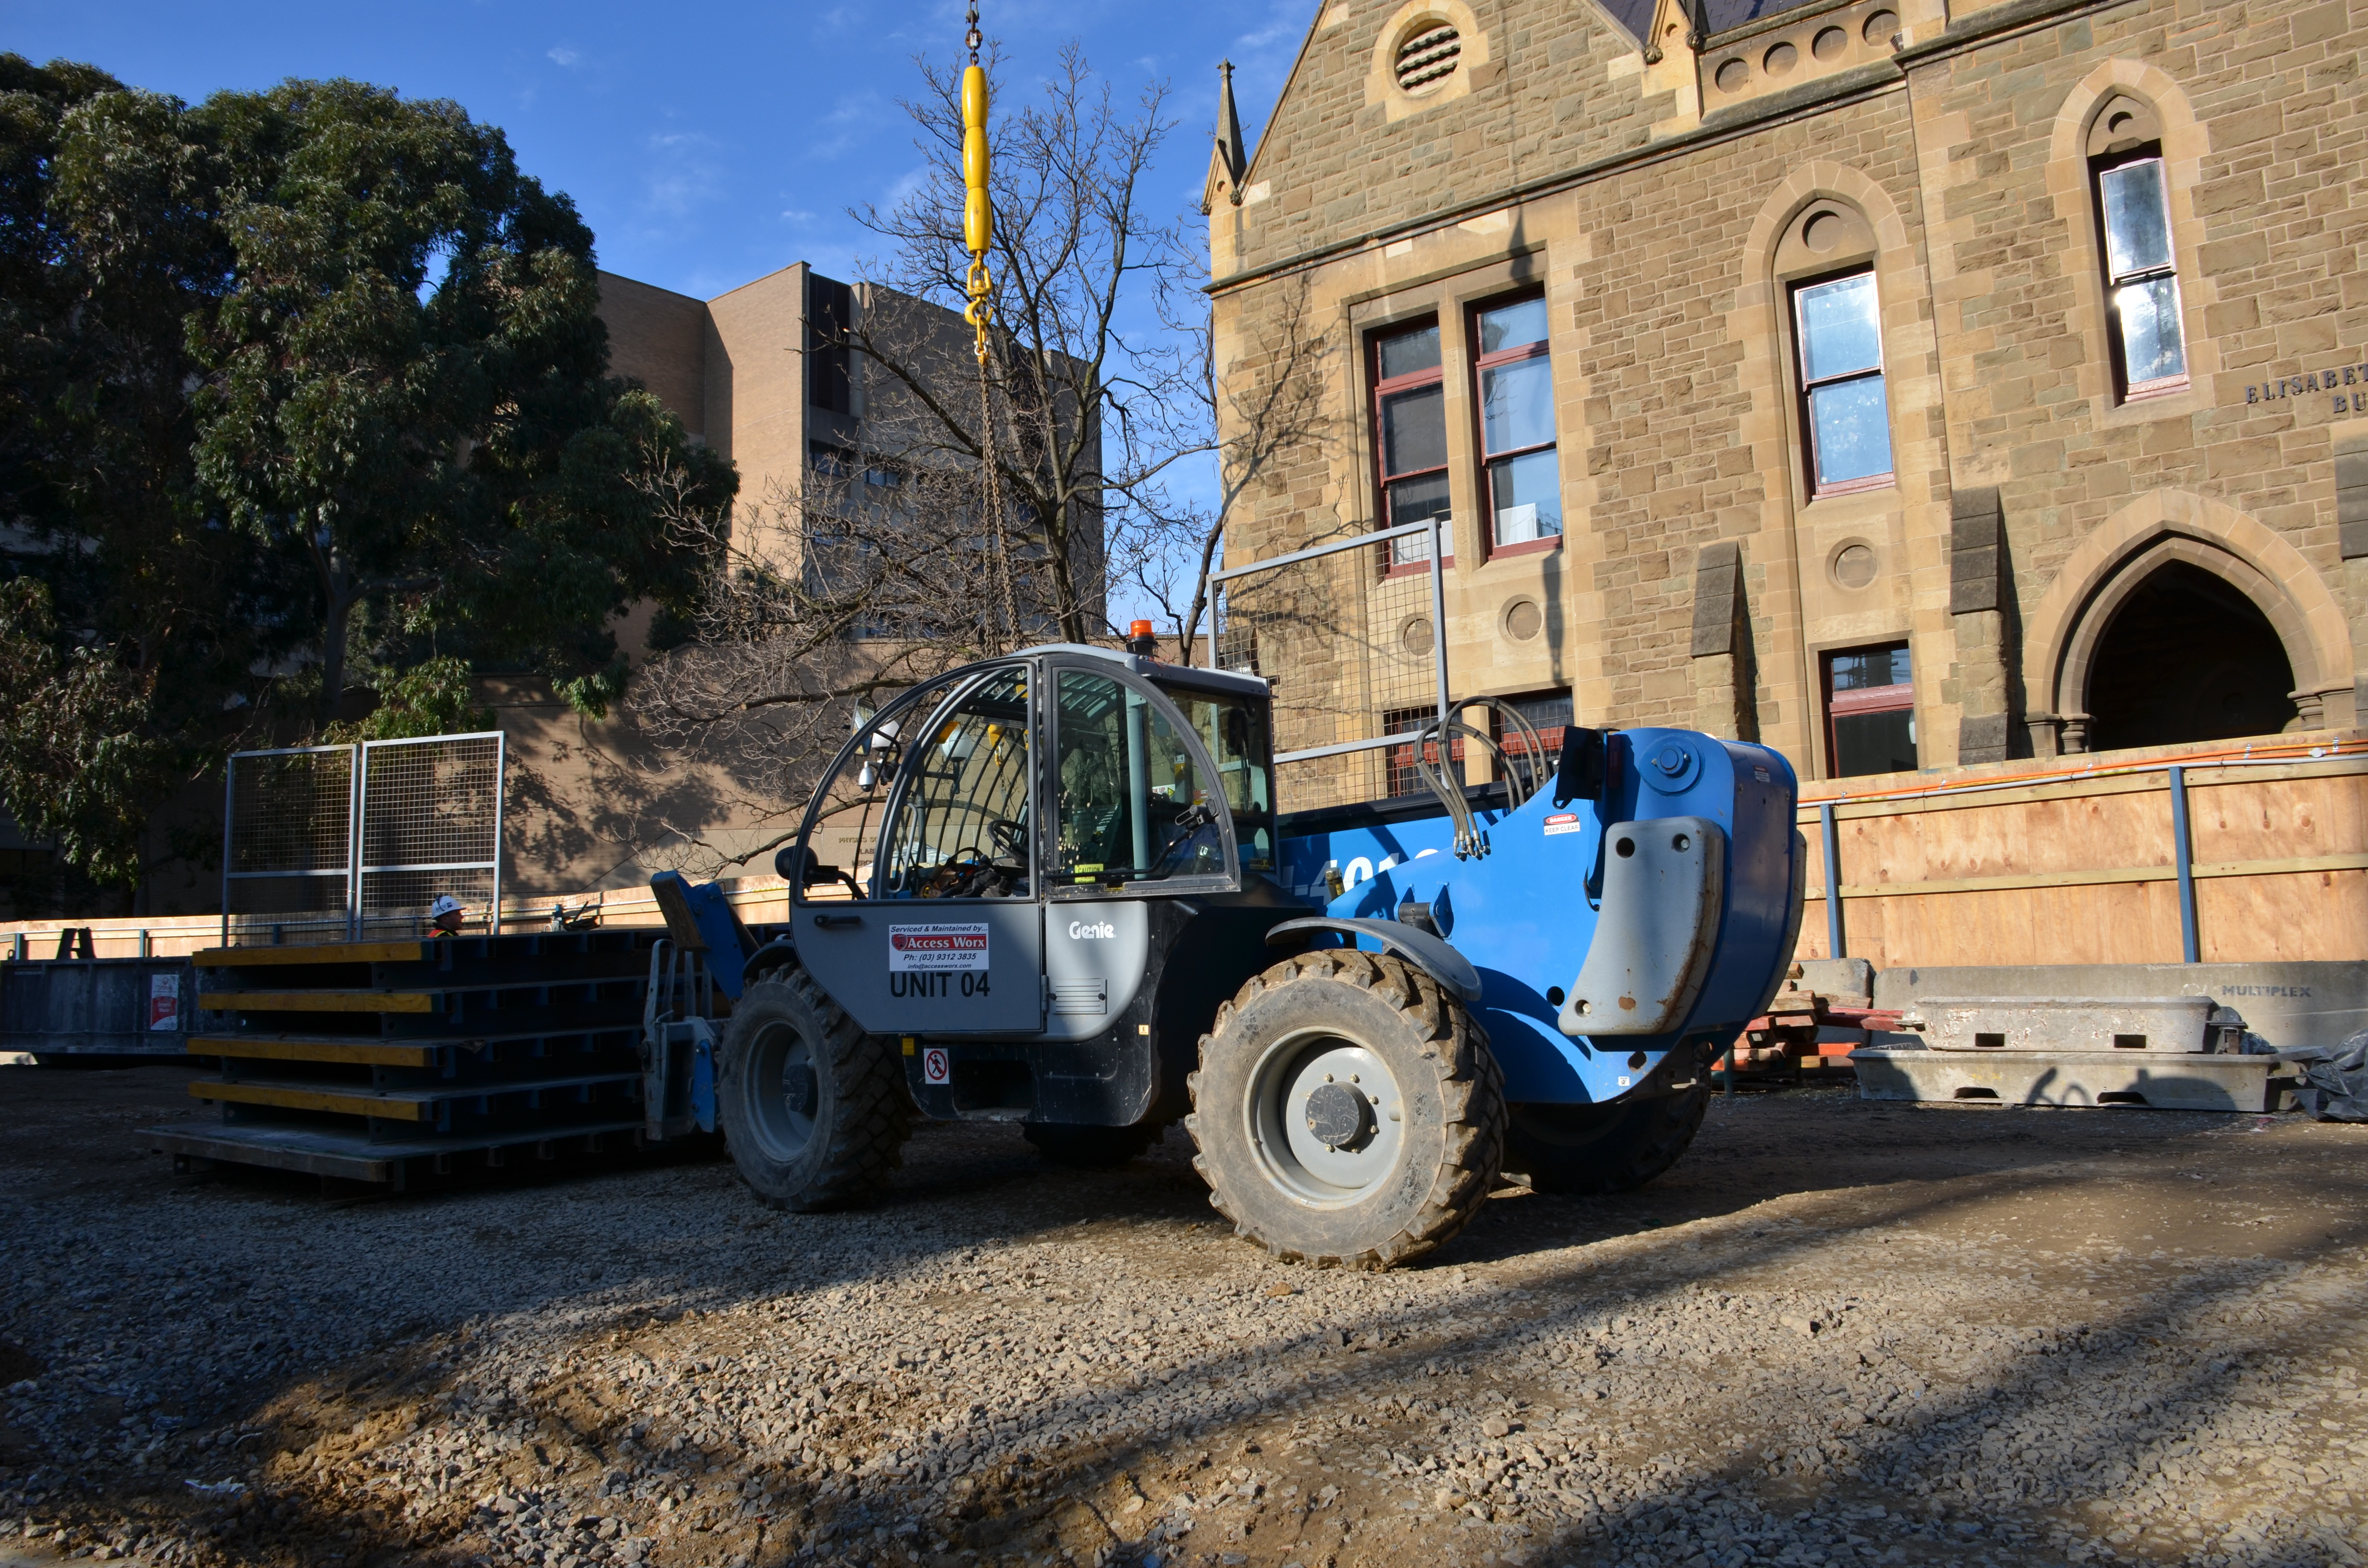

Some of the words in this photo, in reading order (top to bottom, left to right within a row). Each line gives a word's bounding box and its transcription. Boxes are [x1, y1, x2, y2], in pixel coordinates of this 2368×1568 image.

[1069, 920, 1115, 940] Genie
[908, 938, 950, 948] Access
[952, 937, 985, 947] Worx
[919, 954, 935, 962] (03)
[890, 972, 952, 997] UNIT
[961, 971, 990, 997] 04
[2222, 985, 2311, 997] MULTIPLEX
